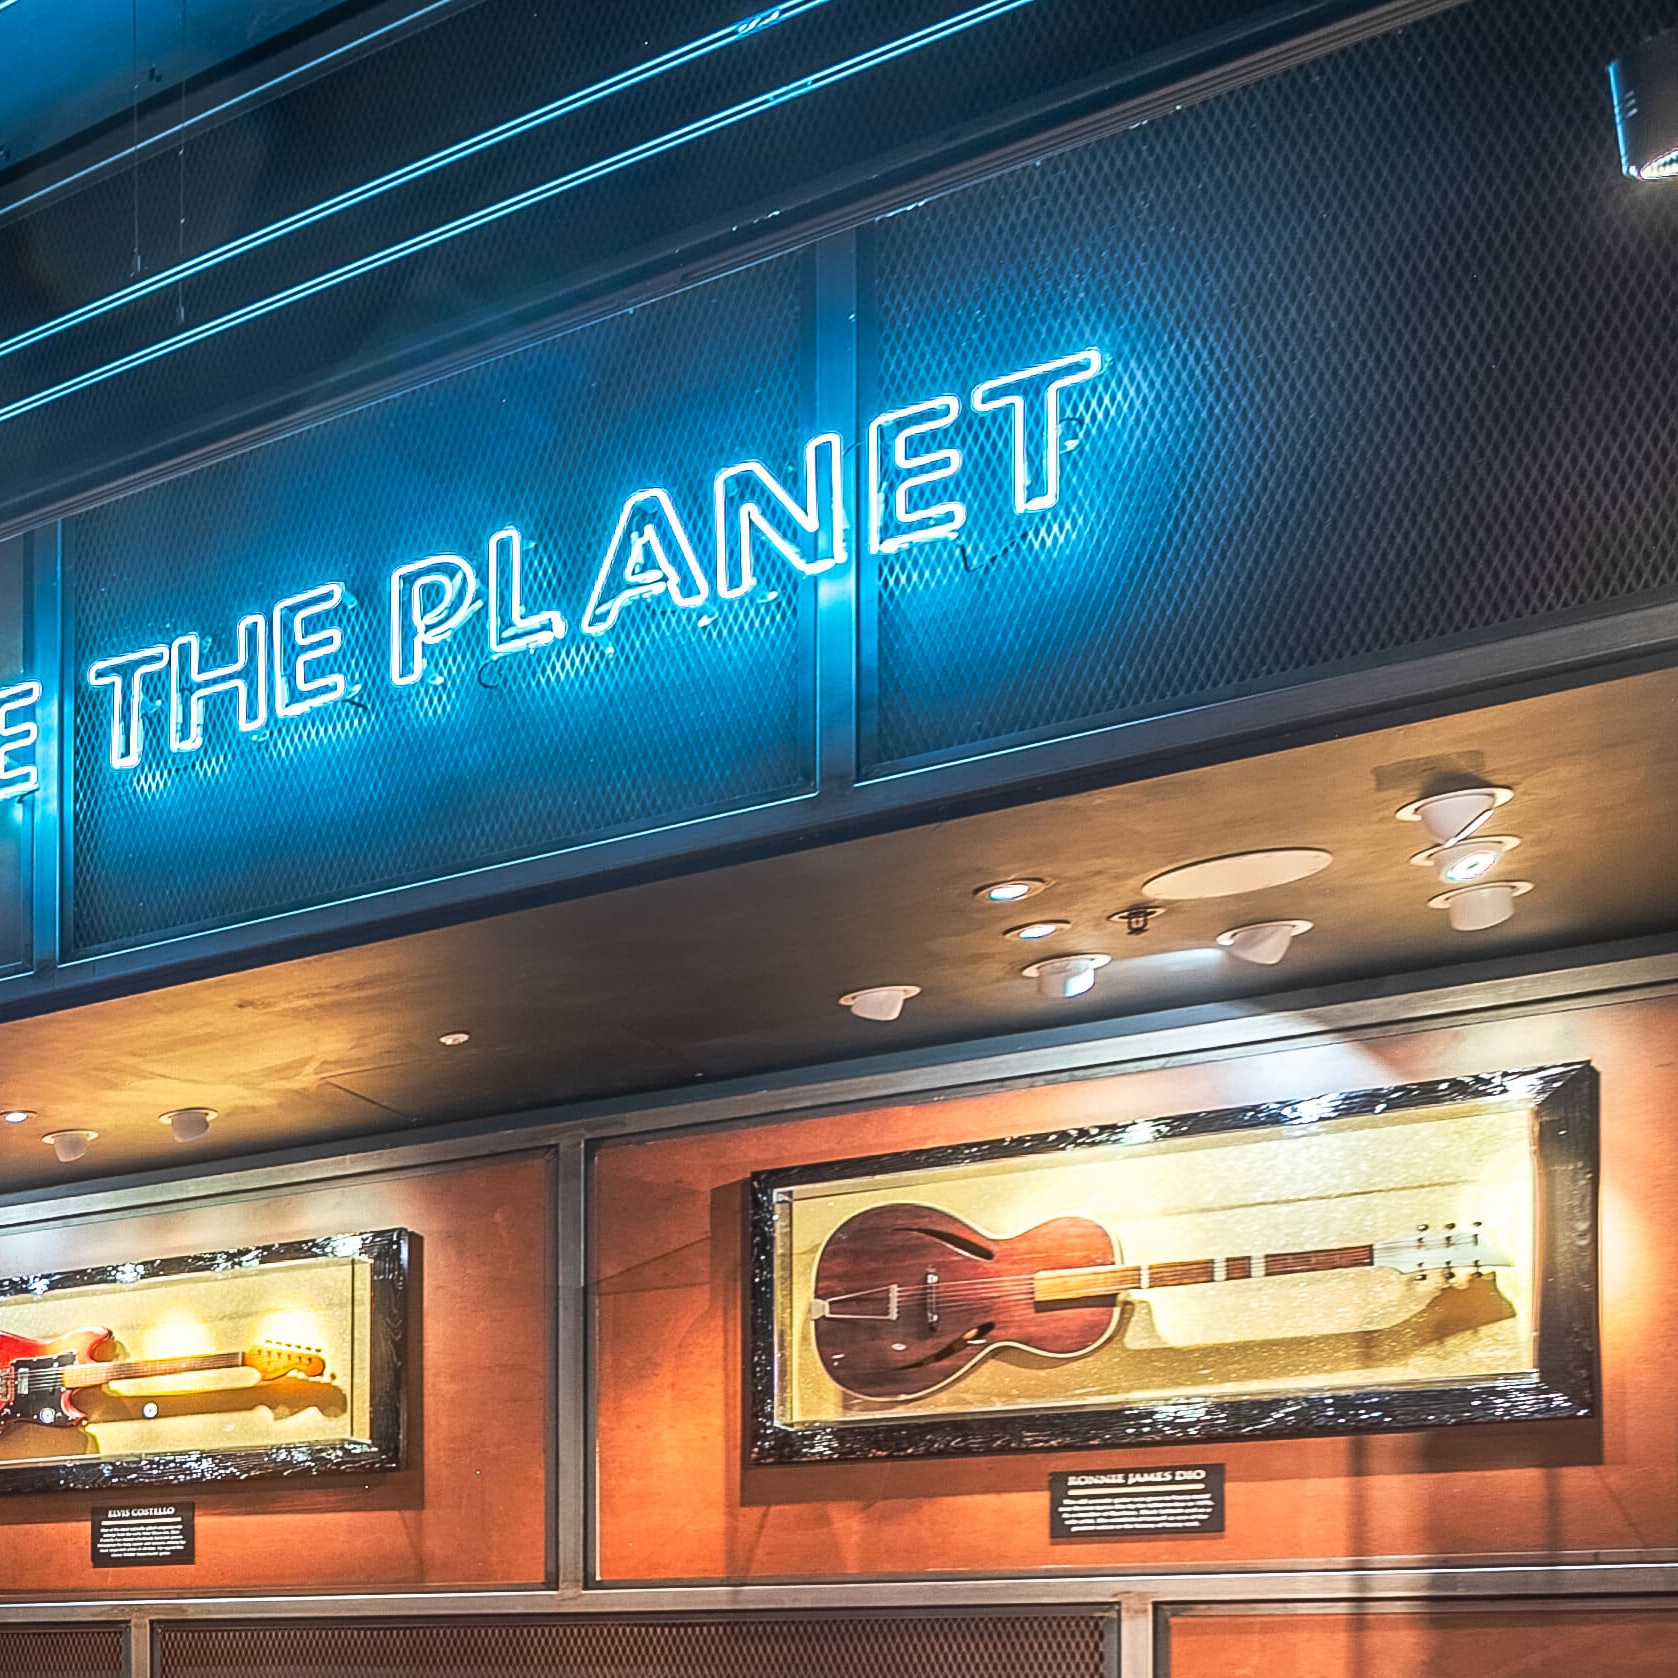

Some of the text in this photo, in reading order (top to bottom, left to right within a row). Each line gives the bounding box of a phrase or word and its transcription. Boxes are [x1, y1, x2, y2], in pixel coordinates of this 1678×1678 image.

[89, 578, 346, 771] THE
[389, 346, 1105, 687] PLANET
[1067, 1469, 1206, 1486] RONNIE JAMES DIO
[107, 1506, 175, 1518] ELVIS COSTELLO
